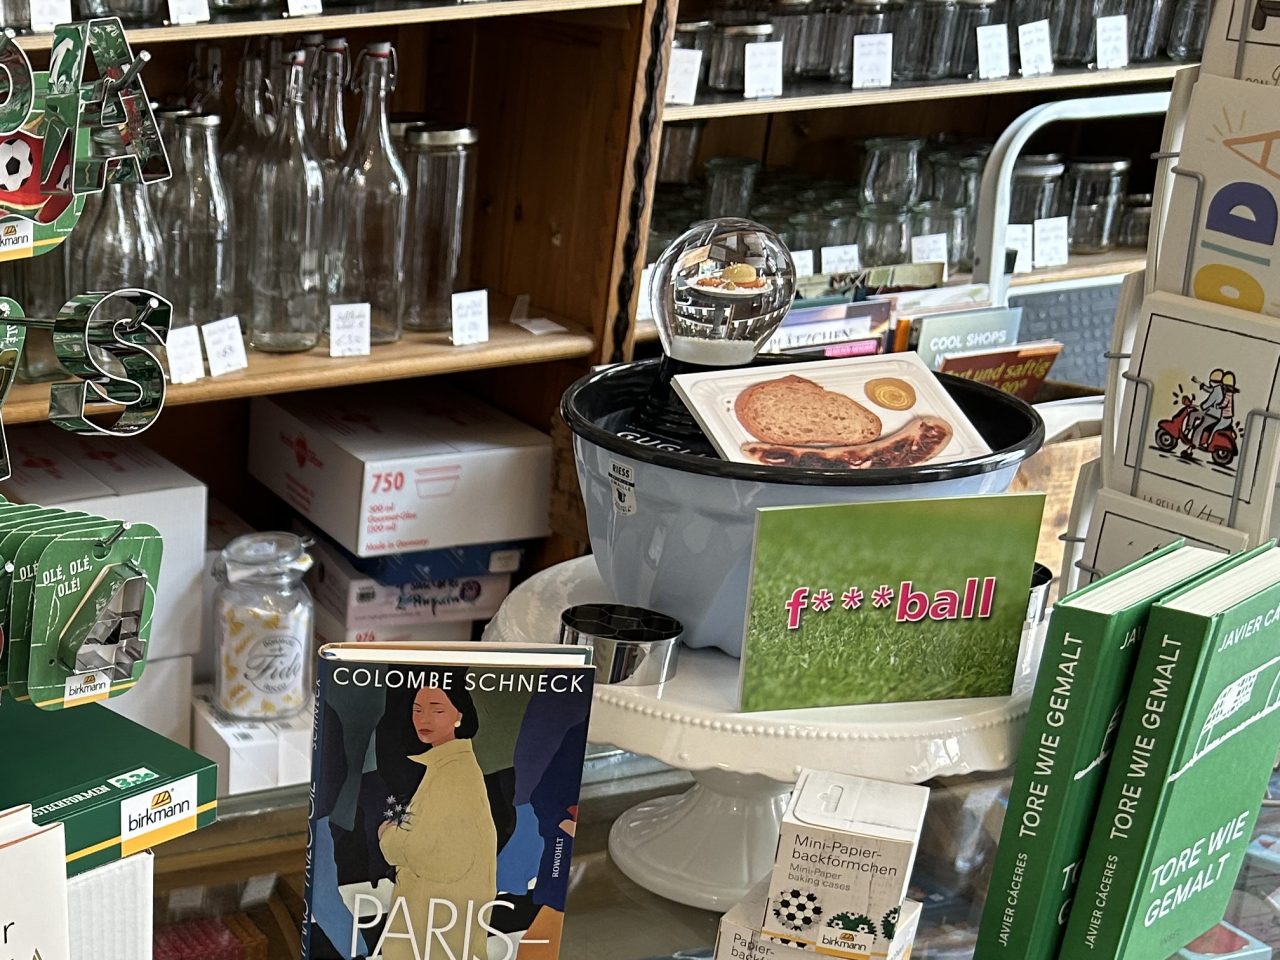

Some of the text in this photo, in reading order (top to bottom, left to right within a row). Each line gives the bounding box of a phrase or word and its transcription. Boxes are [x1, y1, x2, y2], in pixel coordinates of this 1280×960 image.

[929, 329, 1007, 351] COOL SHOPS
[1005, 359, 1051, 378] saftig
[370, 470, 405, 494] 750
[612, 463, 630, 478] RIESS
[42, 554, 93, 586] OLÉ, OLÉ,
[57, 577, 81, 598] OLÉ!
[1218, 619, 1263, 654] JAVIER
[68, 681, 107, 697] birkmann
[332, 666, 586, 694] COLOMBE SCHNECK
[1047, 632, 1085, 727] GEMALT
[1033, 731, 1061, 778] WIE
[1083, 907, 1105, 950] JAVIER
[1109, 786, 1142, 840] TORE
[1126, 732, 1157, 780] WIE
[1142, 633, 1183, 730] GEMALT
[127, 799, 191, 832] birkmann
[1018, 784, 1049, 840] TORE
[551, 836, 565, 878] ROWOHLT
[793, 833, 883, 860] Mini-Papier-
[1149, 811, 1250, 895] TORE WIE
[791, 848, 898, 878] backförmchen
[787, 872, 820, 887] baking
[1144, 852, 1232, 928] GEMALT
[997, 906, 1017, 948] JAVIER
[732, 932, 776, 957] Papier-
[820, 935, 867, 951] birkmann
